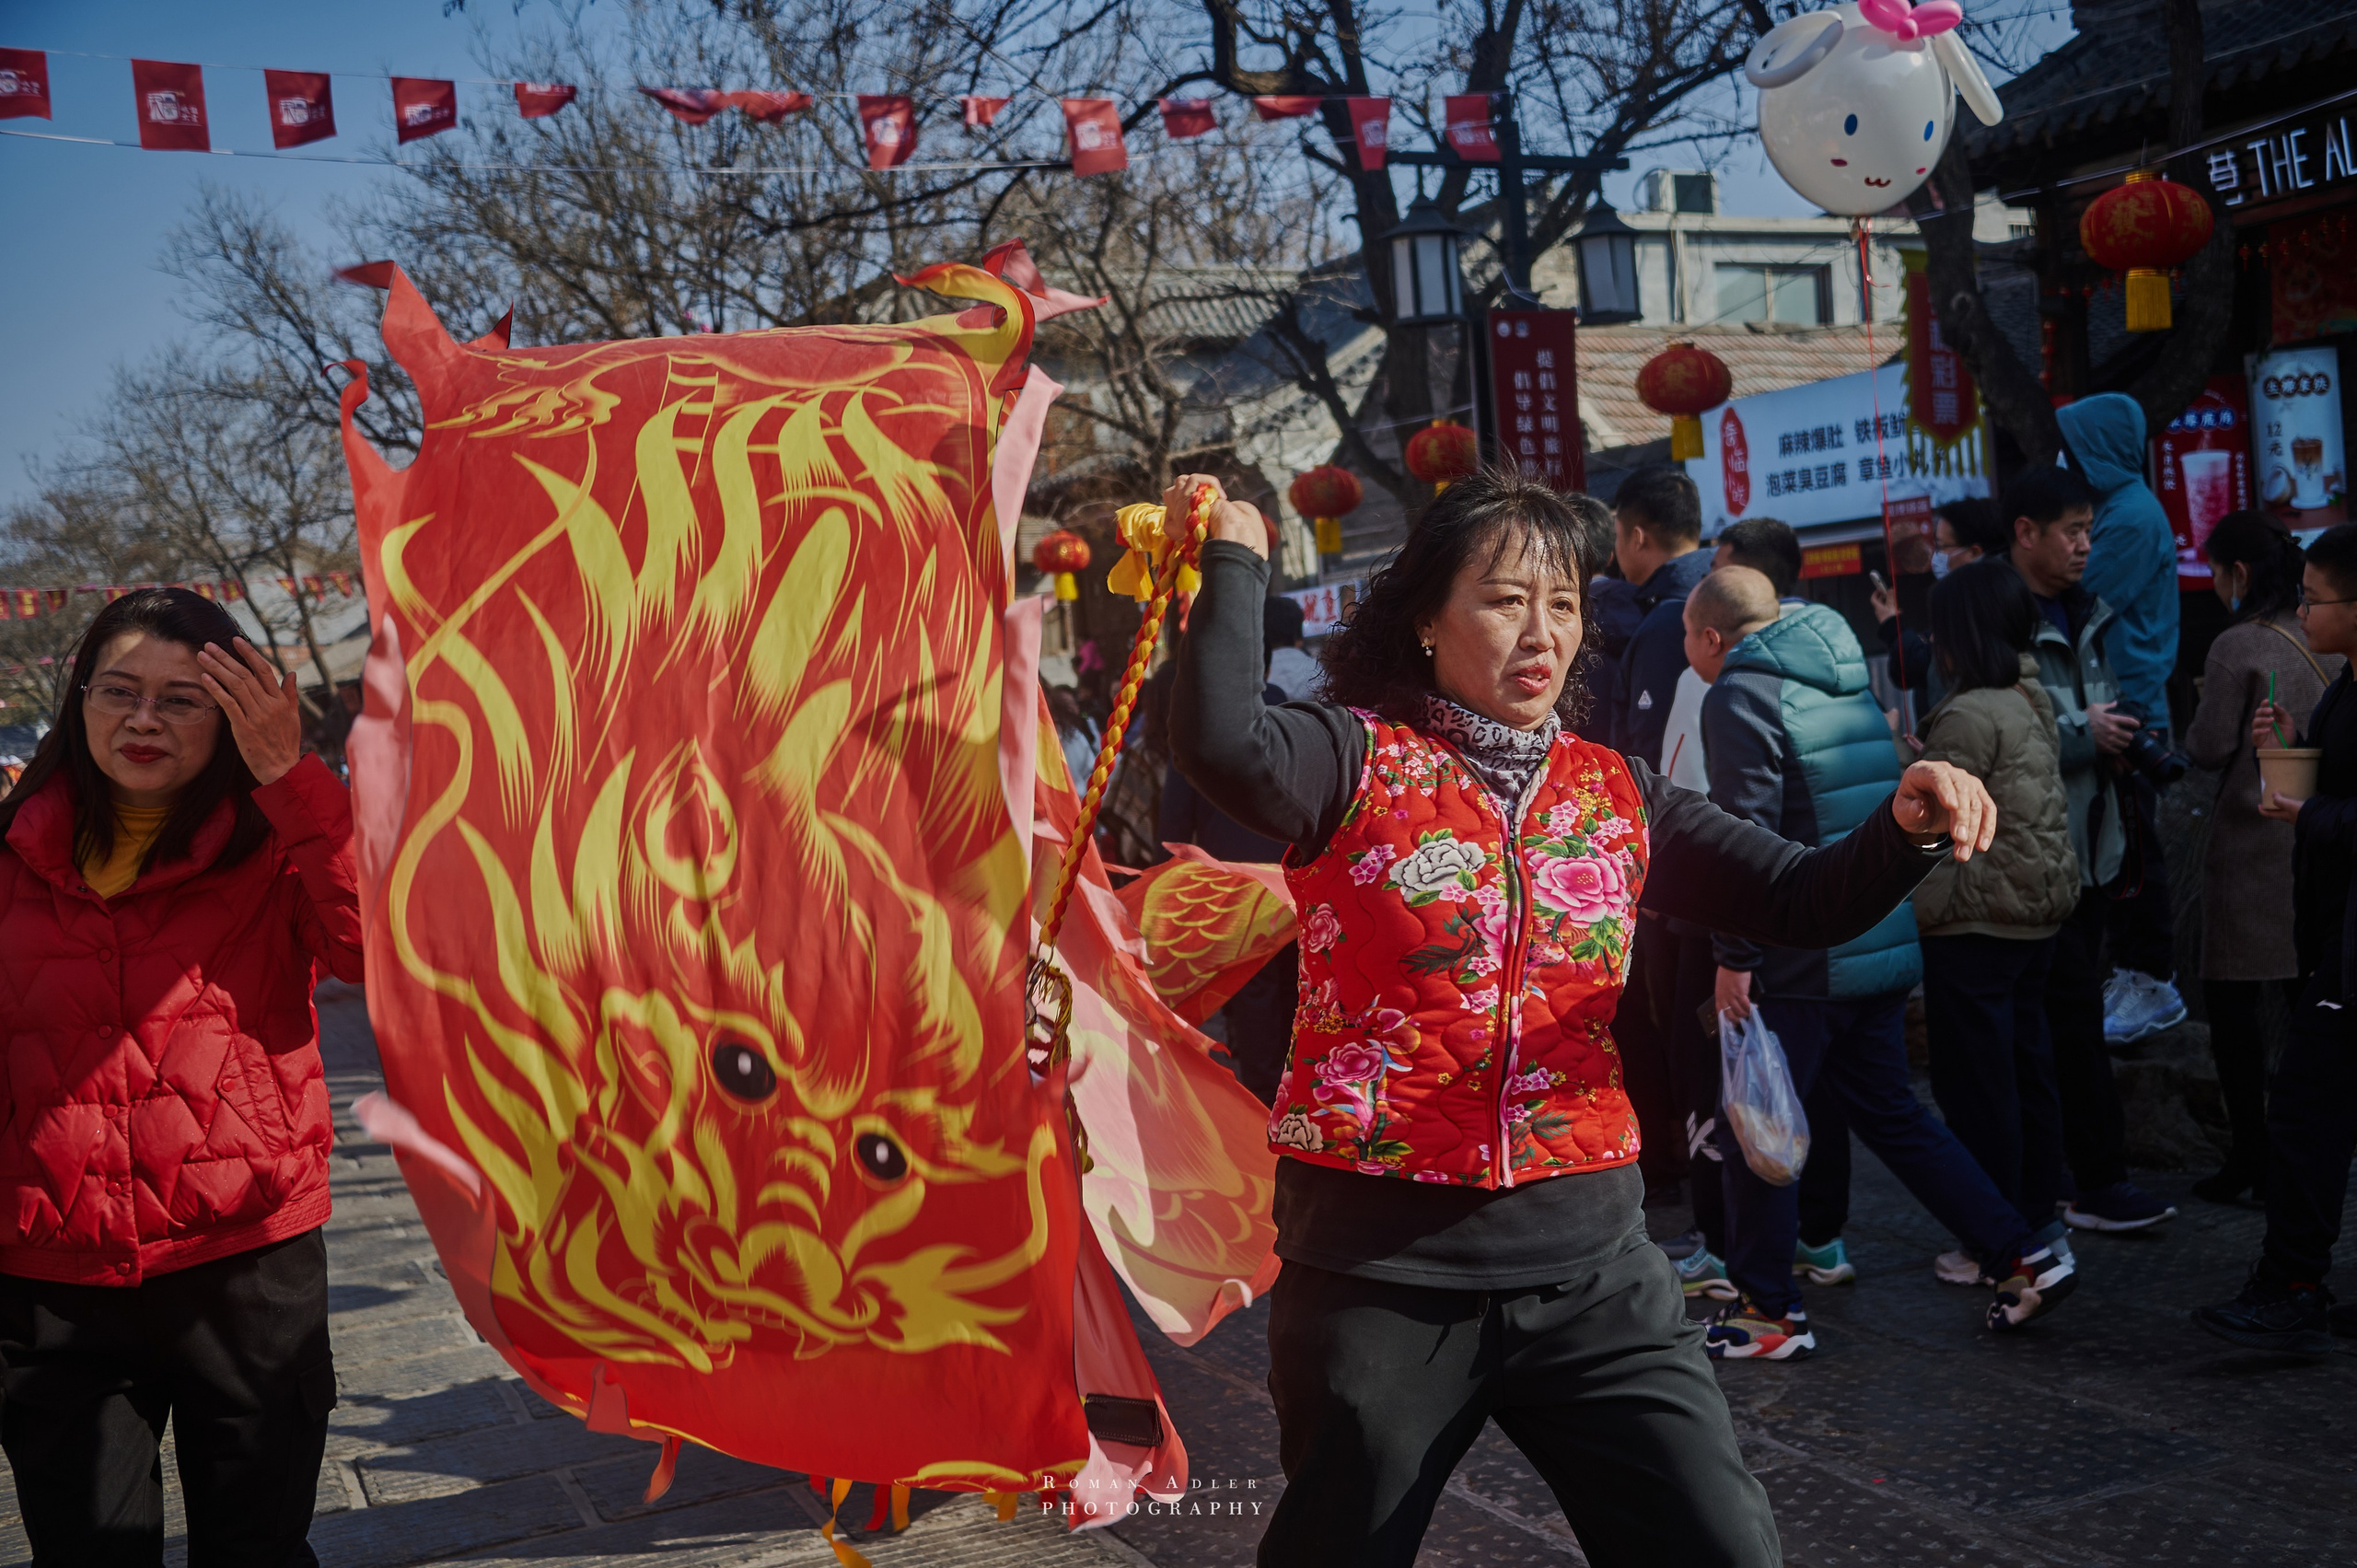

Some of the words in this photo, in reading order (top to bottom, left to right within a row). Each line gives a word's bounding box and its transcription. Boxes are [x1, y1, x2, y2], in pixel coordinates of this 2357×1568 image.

[2247, 128, 2315, 197] THE
[1778, 423, 1844, 459] 麻辣爆肚
[1853, 412, 1920, 444] 铁板鱿
[1766, 461, 1848, 497] 泡菜臭豆腐
